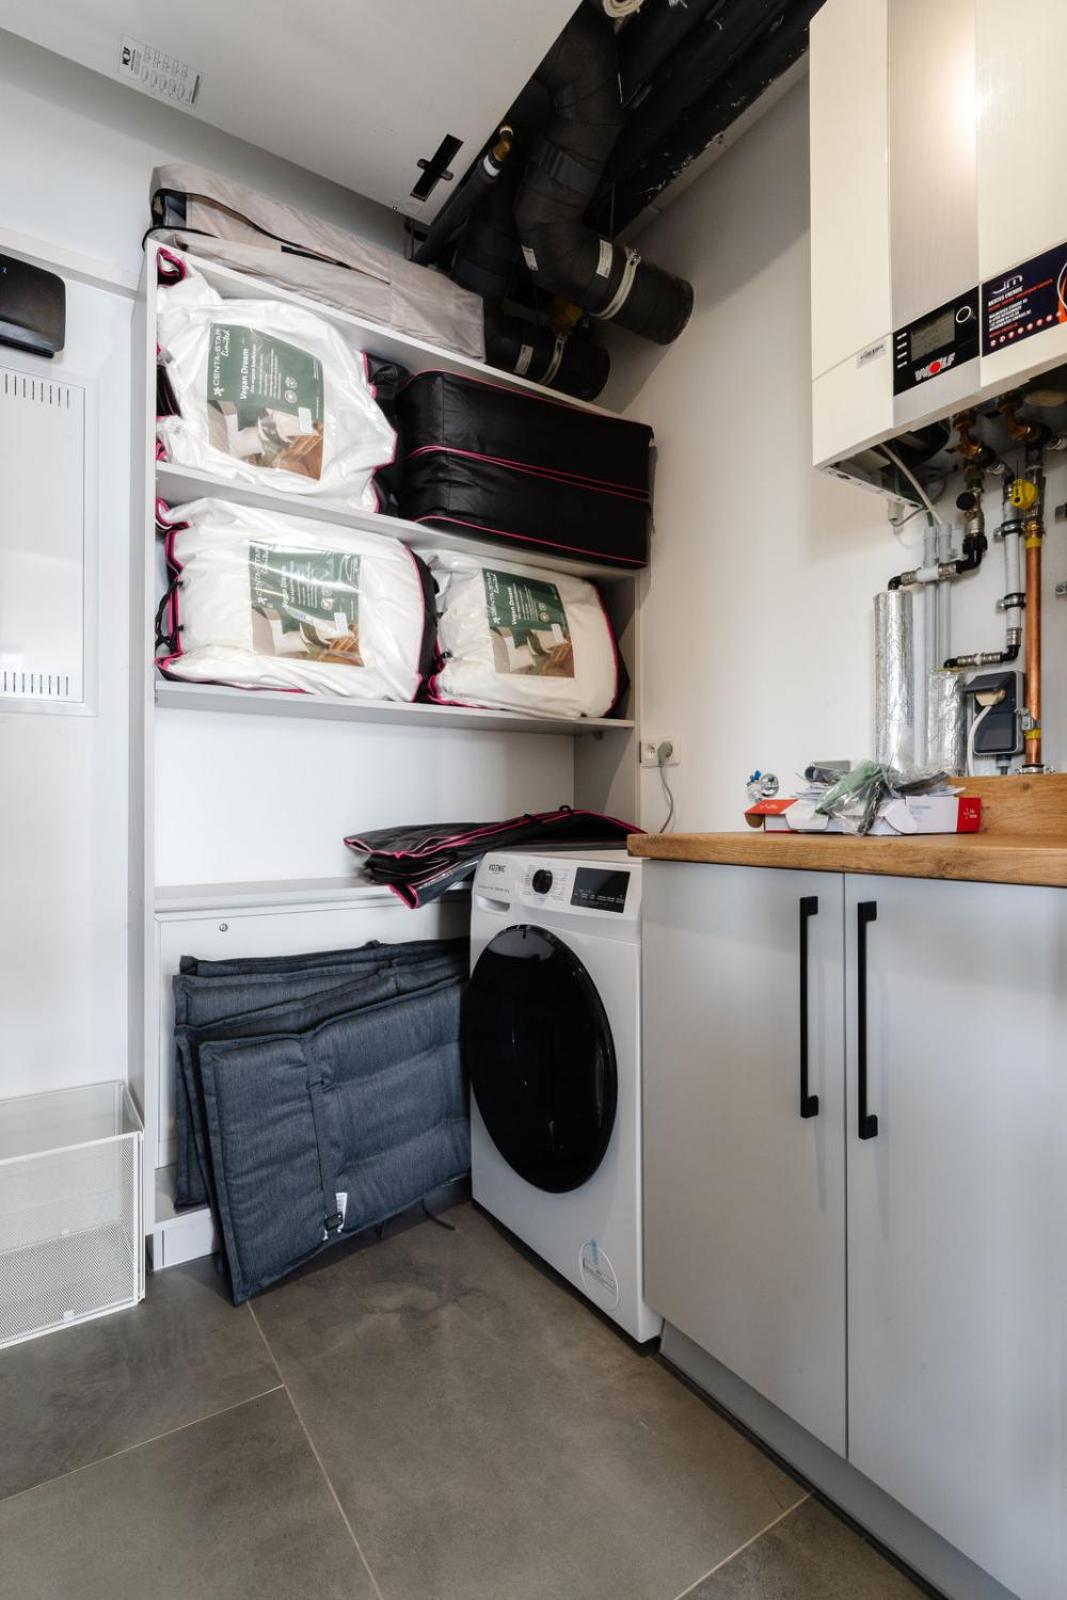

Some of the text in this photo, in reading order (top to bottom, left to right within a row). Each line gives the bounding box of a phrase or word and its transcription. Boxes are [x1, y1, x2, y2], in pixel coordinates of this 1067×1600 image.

[213, 328, 222, 386] CENTA-STAR
[240, 348, 250, 400] Vegan Dream
[914, 352, 956, 382] WOLF
